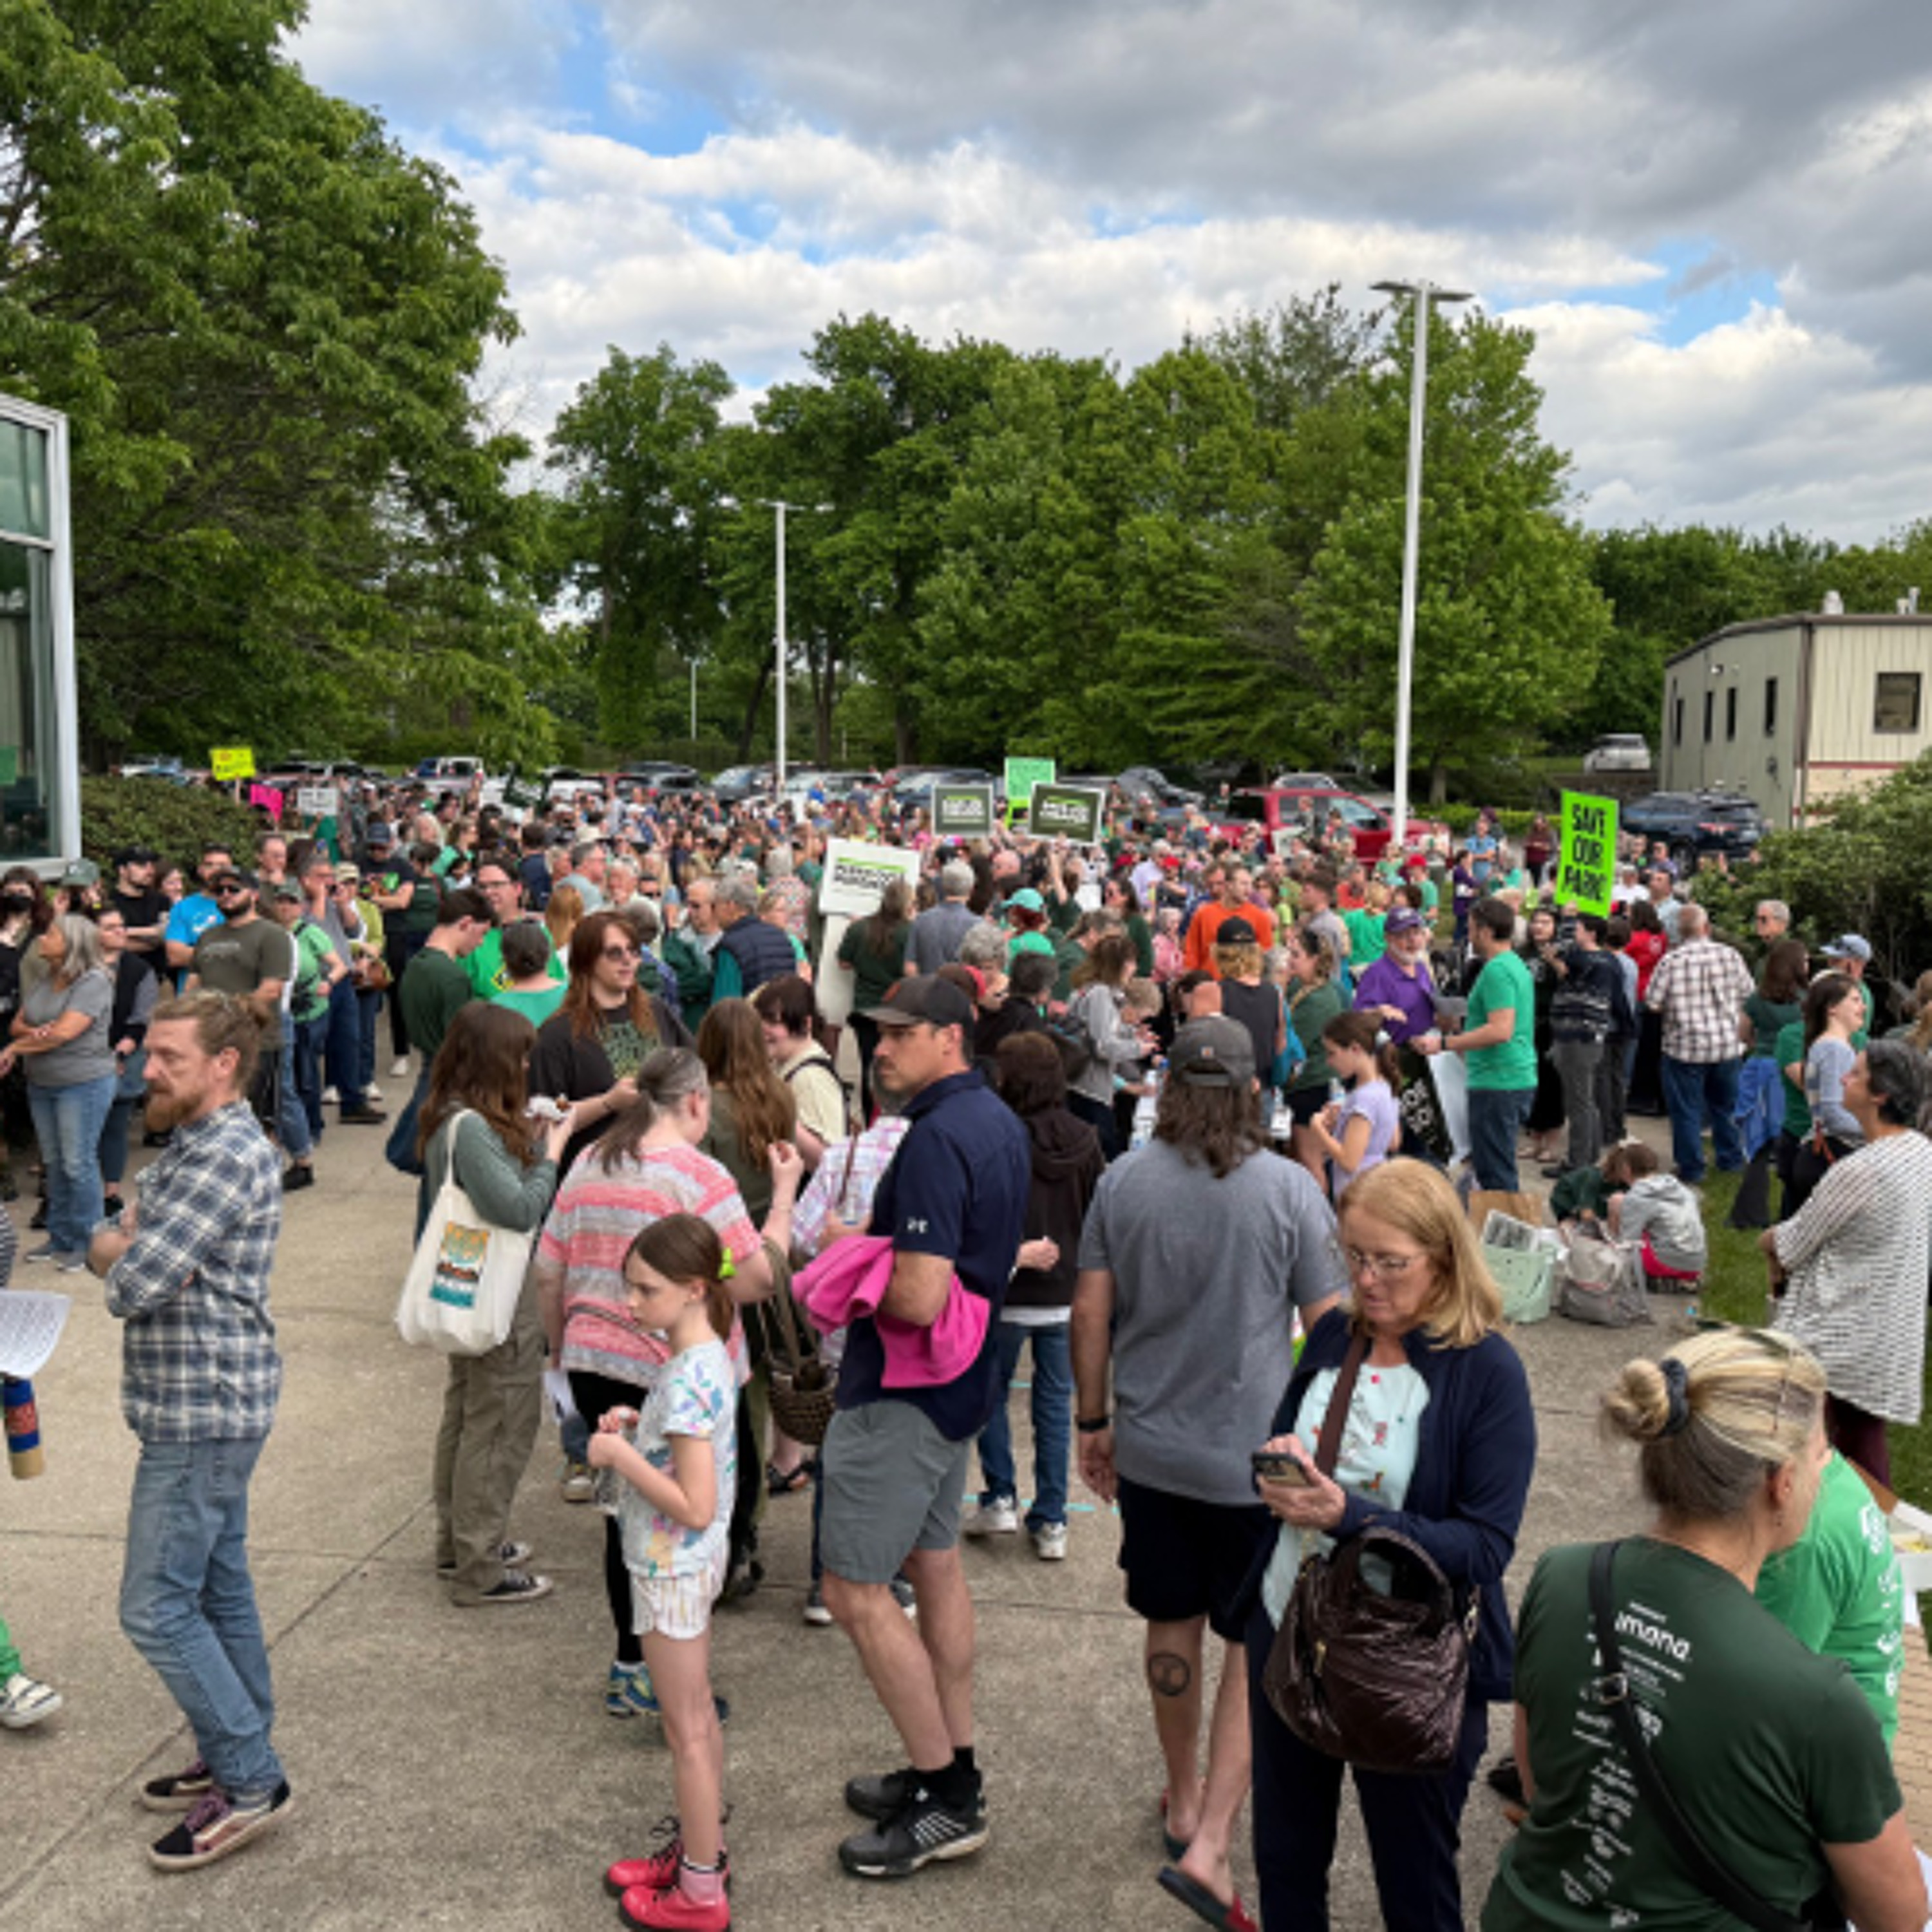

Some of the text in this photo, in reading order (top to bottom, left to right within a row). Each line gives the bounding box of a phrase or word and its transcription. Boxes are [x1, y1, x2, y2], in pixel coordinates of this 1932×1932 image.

[1573, 804, 1606, 837] SAVE
[1573, 835, 1604, 867] OUR
[1561, 865, 1607, 902] PARK
